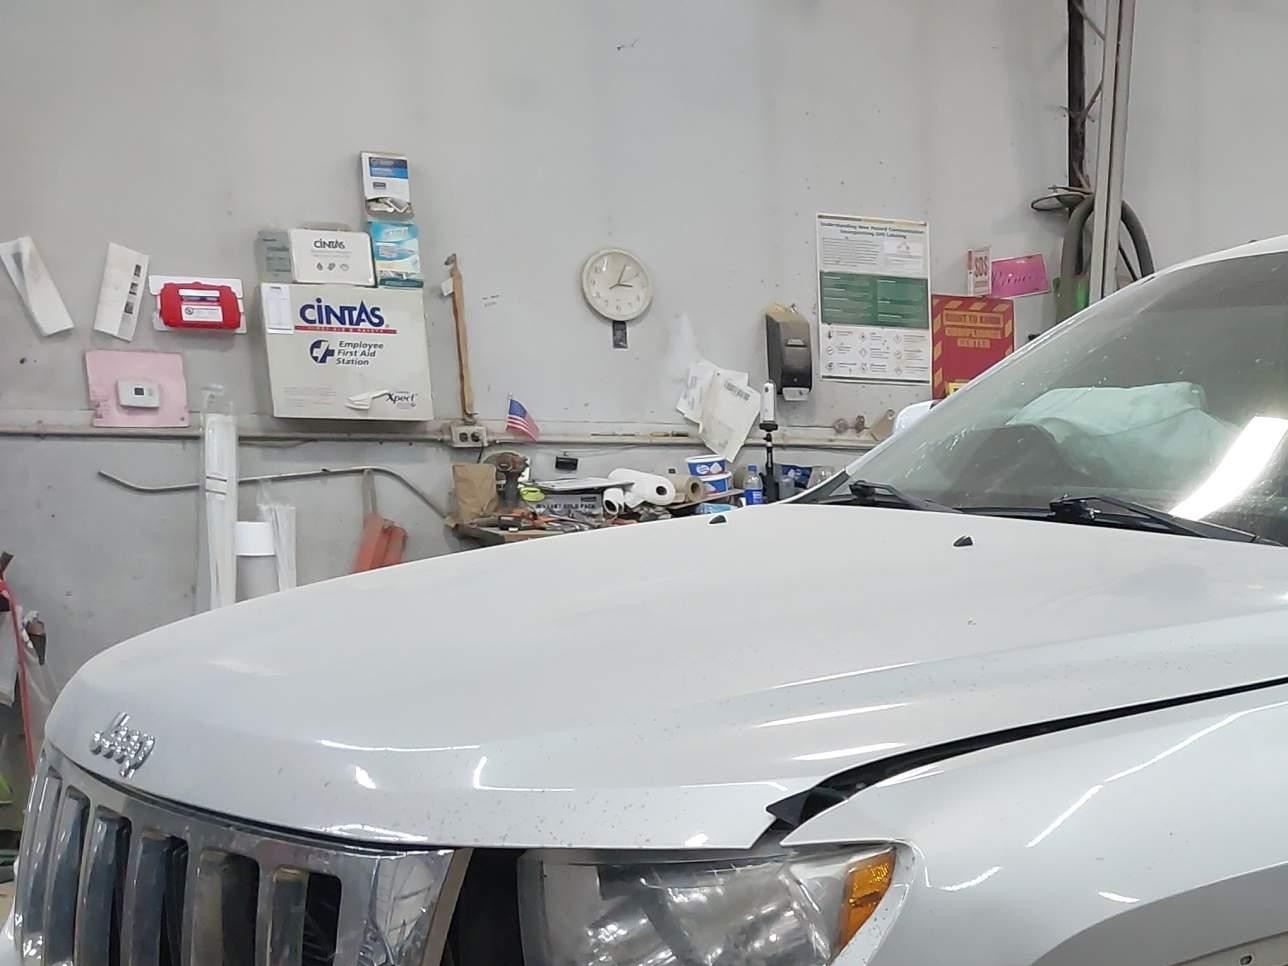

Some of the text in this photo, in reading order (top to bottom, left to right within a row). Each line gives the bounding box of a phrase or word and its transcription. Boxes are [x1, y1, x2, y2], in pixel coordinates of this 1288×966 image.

[338, 340, 384, 352] Employee
[337, 349, 376, 358] First Aid
[335, 358, 369, 366] Station
[90, 711, 156, 779] Jeep
